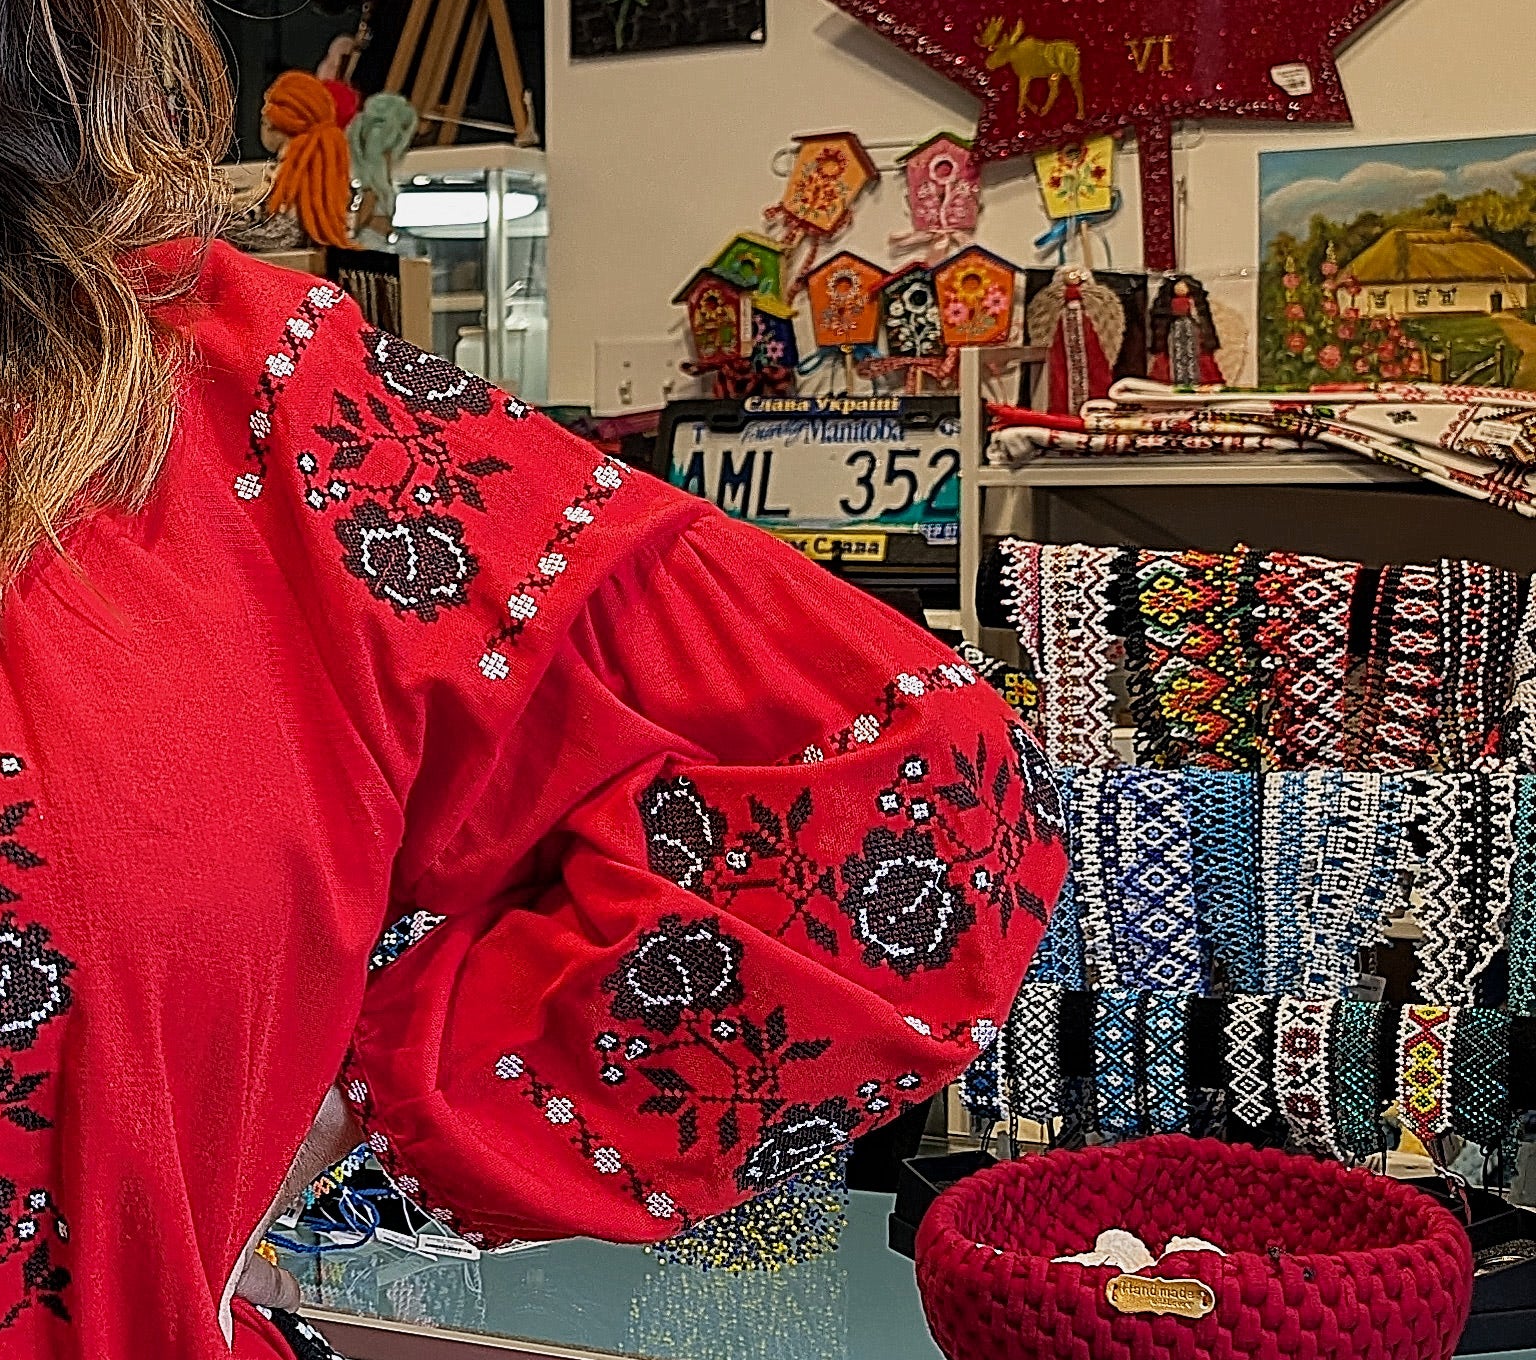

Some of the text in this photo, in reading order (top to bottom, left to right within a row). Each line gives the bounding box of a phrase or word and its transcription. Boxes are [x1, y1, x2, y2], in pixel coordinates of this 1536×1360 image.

[1124, 34, 1176, 74] VI
[683, 447, 961, 518] AML 352
[1119, 1280, 1195, 1301] Hand made
